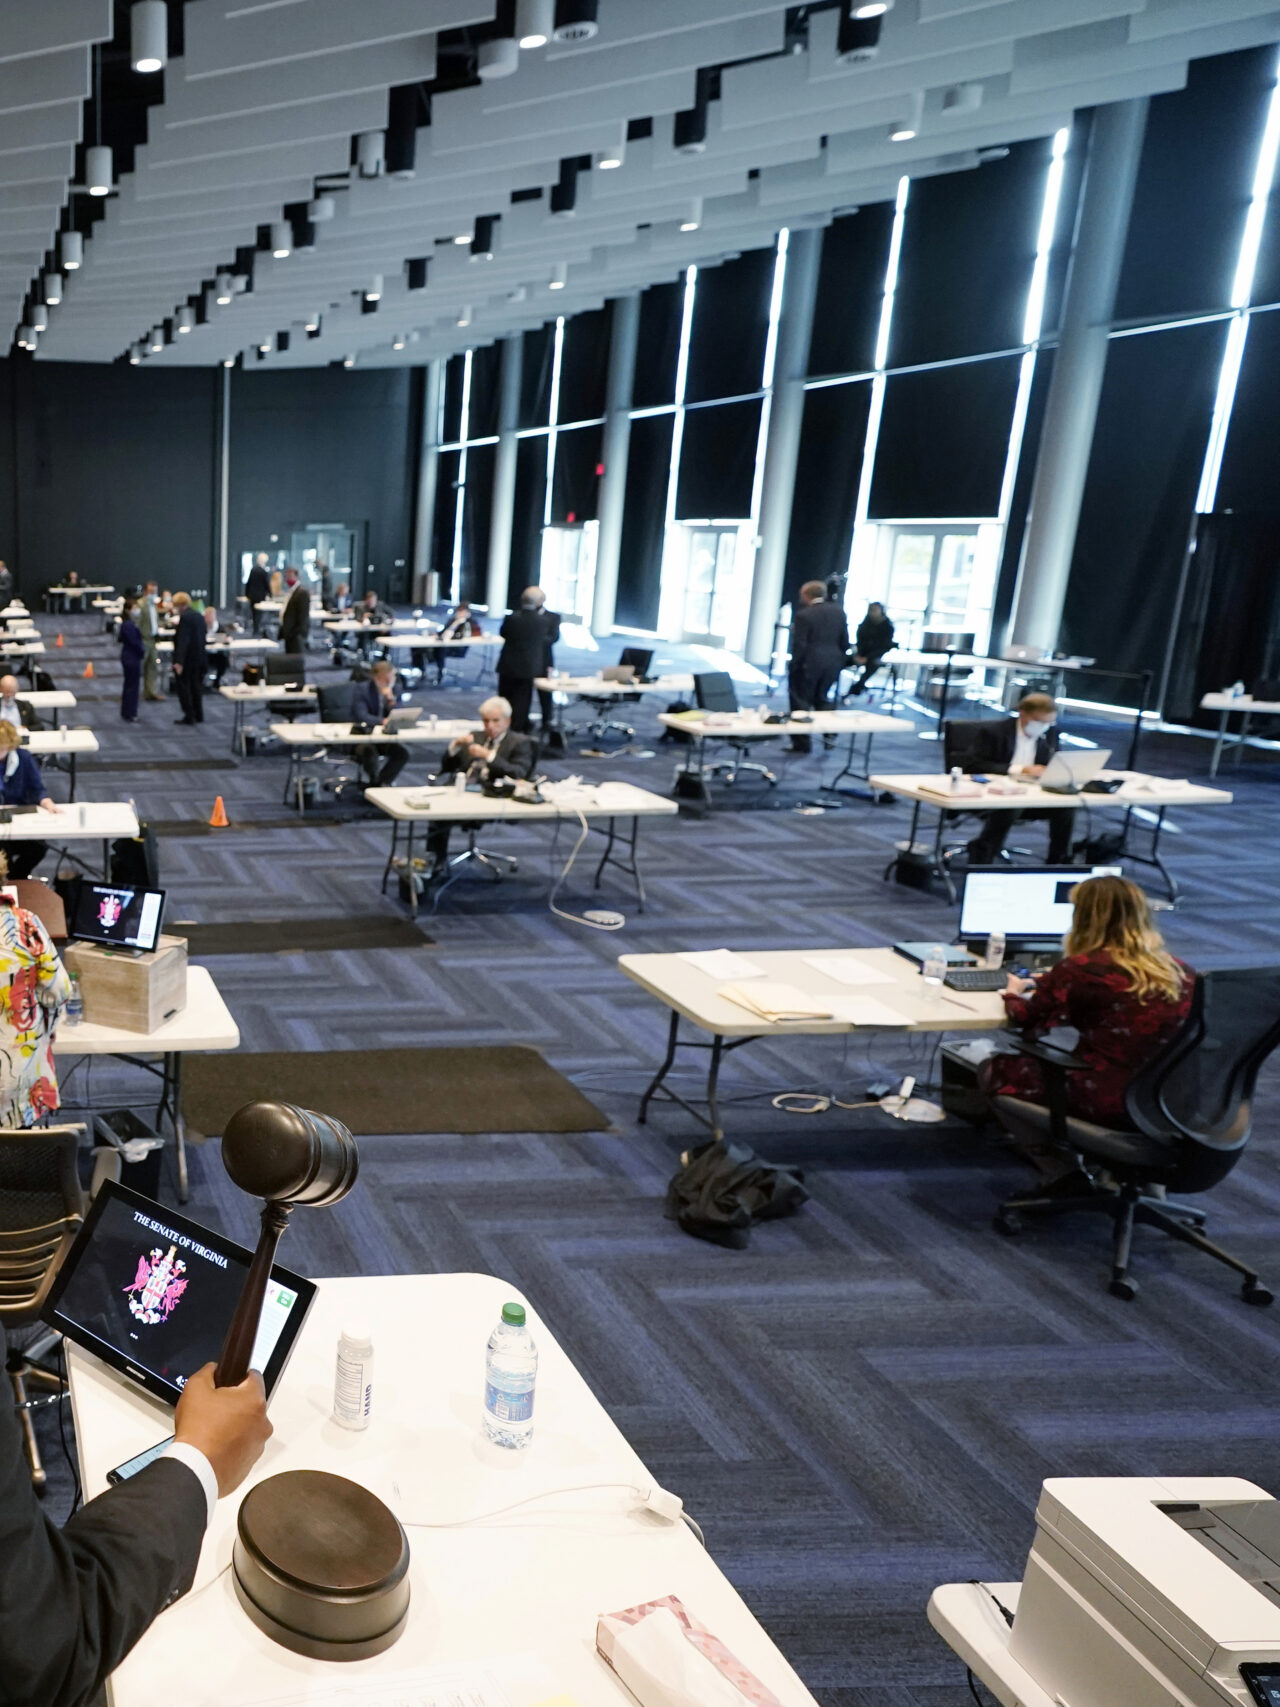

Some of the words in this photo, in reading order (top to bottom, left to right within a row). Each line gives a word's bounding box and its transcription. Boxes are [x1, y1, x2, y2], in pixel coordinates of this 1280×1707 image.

[133, 1211, 150, 1227] THE
[149, 1220, 179, 1242] SENATE
[178, 1236, 192, 1248] OF
[190, 1241, 228, 1269] VIRGINIA
[364, 1384, 372, 1416] HAND
